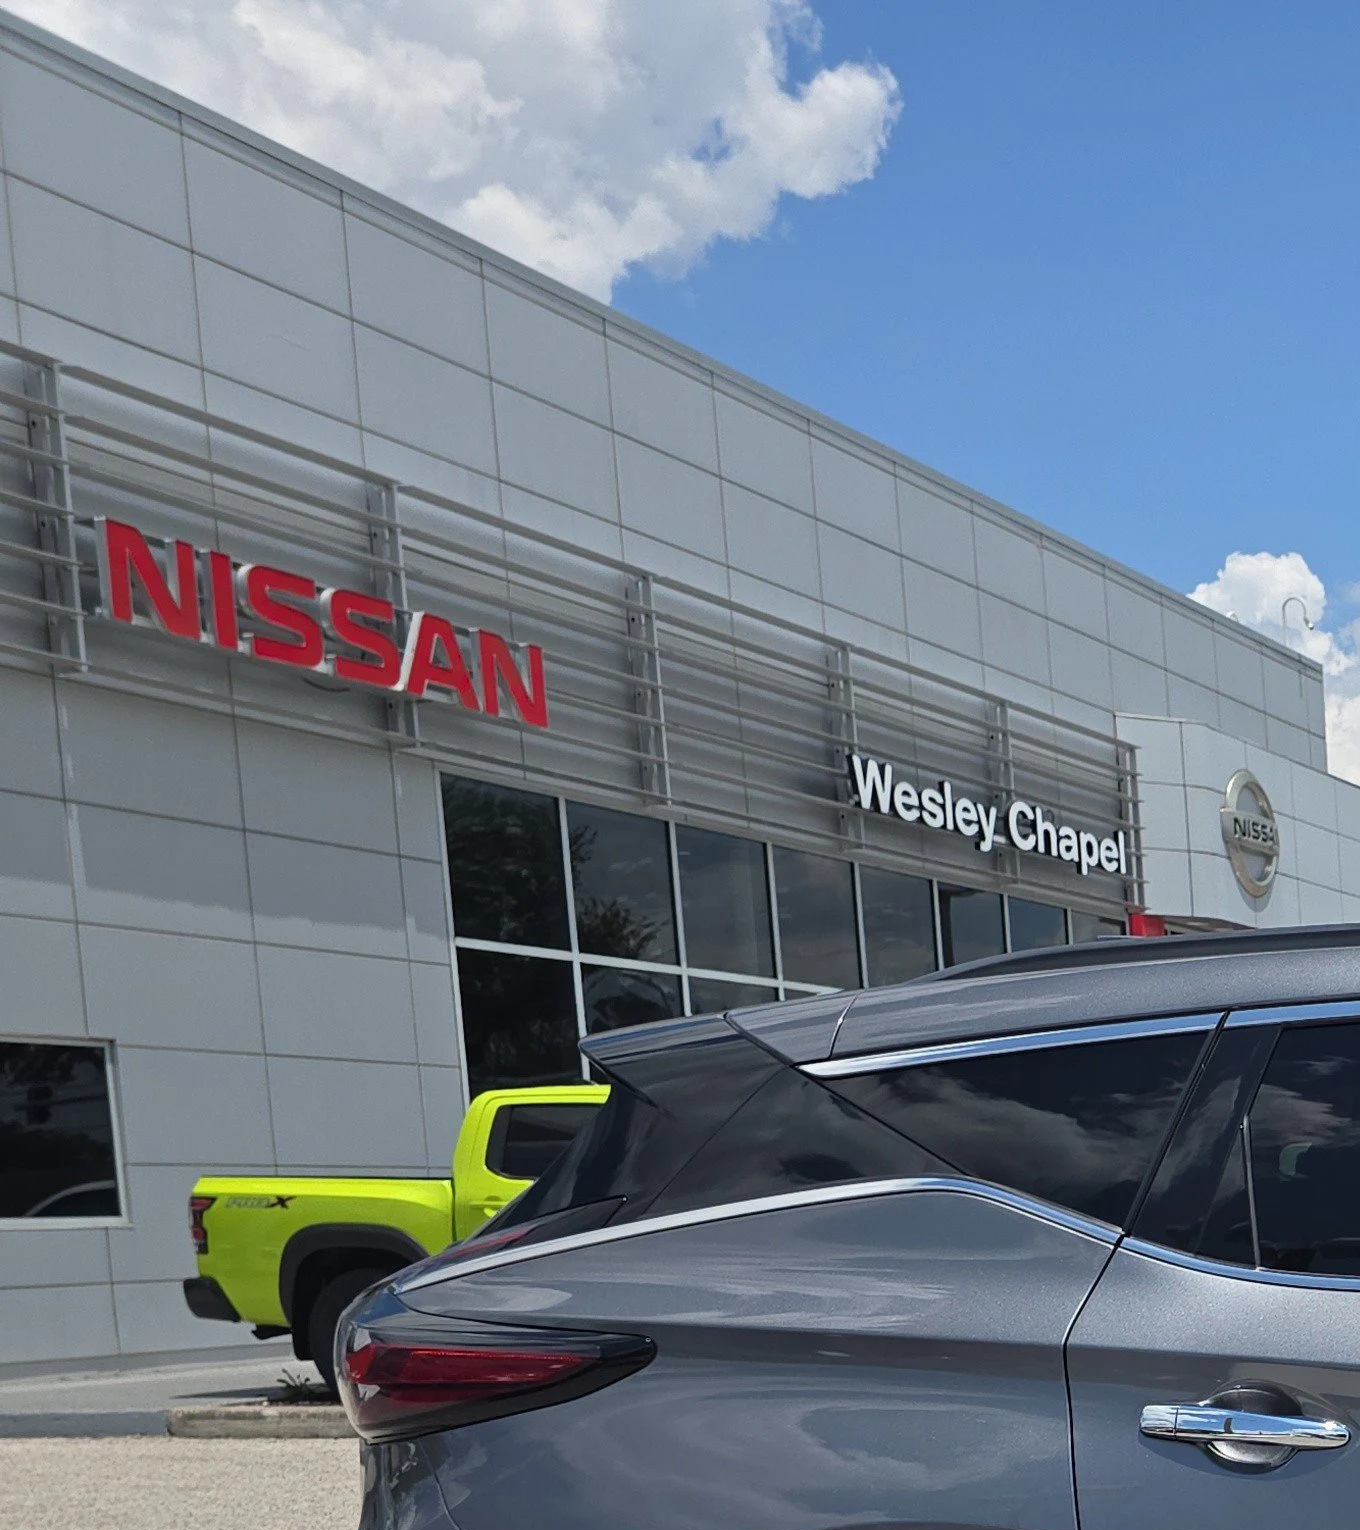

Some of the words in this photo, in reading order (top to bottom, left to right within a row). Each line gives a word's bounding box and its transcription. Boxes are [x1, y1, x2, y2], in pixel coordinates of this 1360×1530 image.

[102, 517, 549, 728] NISSAN
[851, 754, 997, 852] Wesley
[1009, 801, 1127, 876] Chapel
[1233, 816, 1278, 845] NISSA
